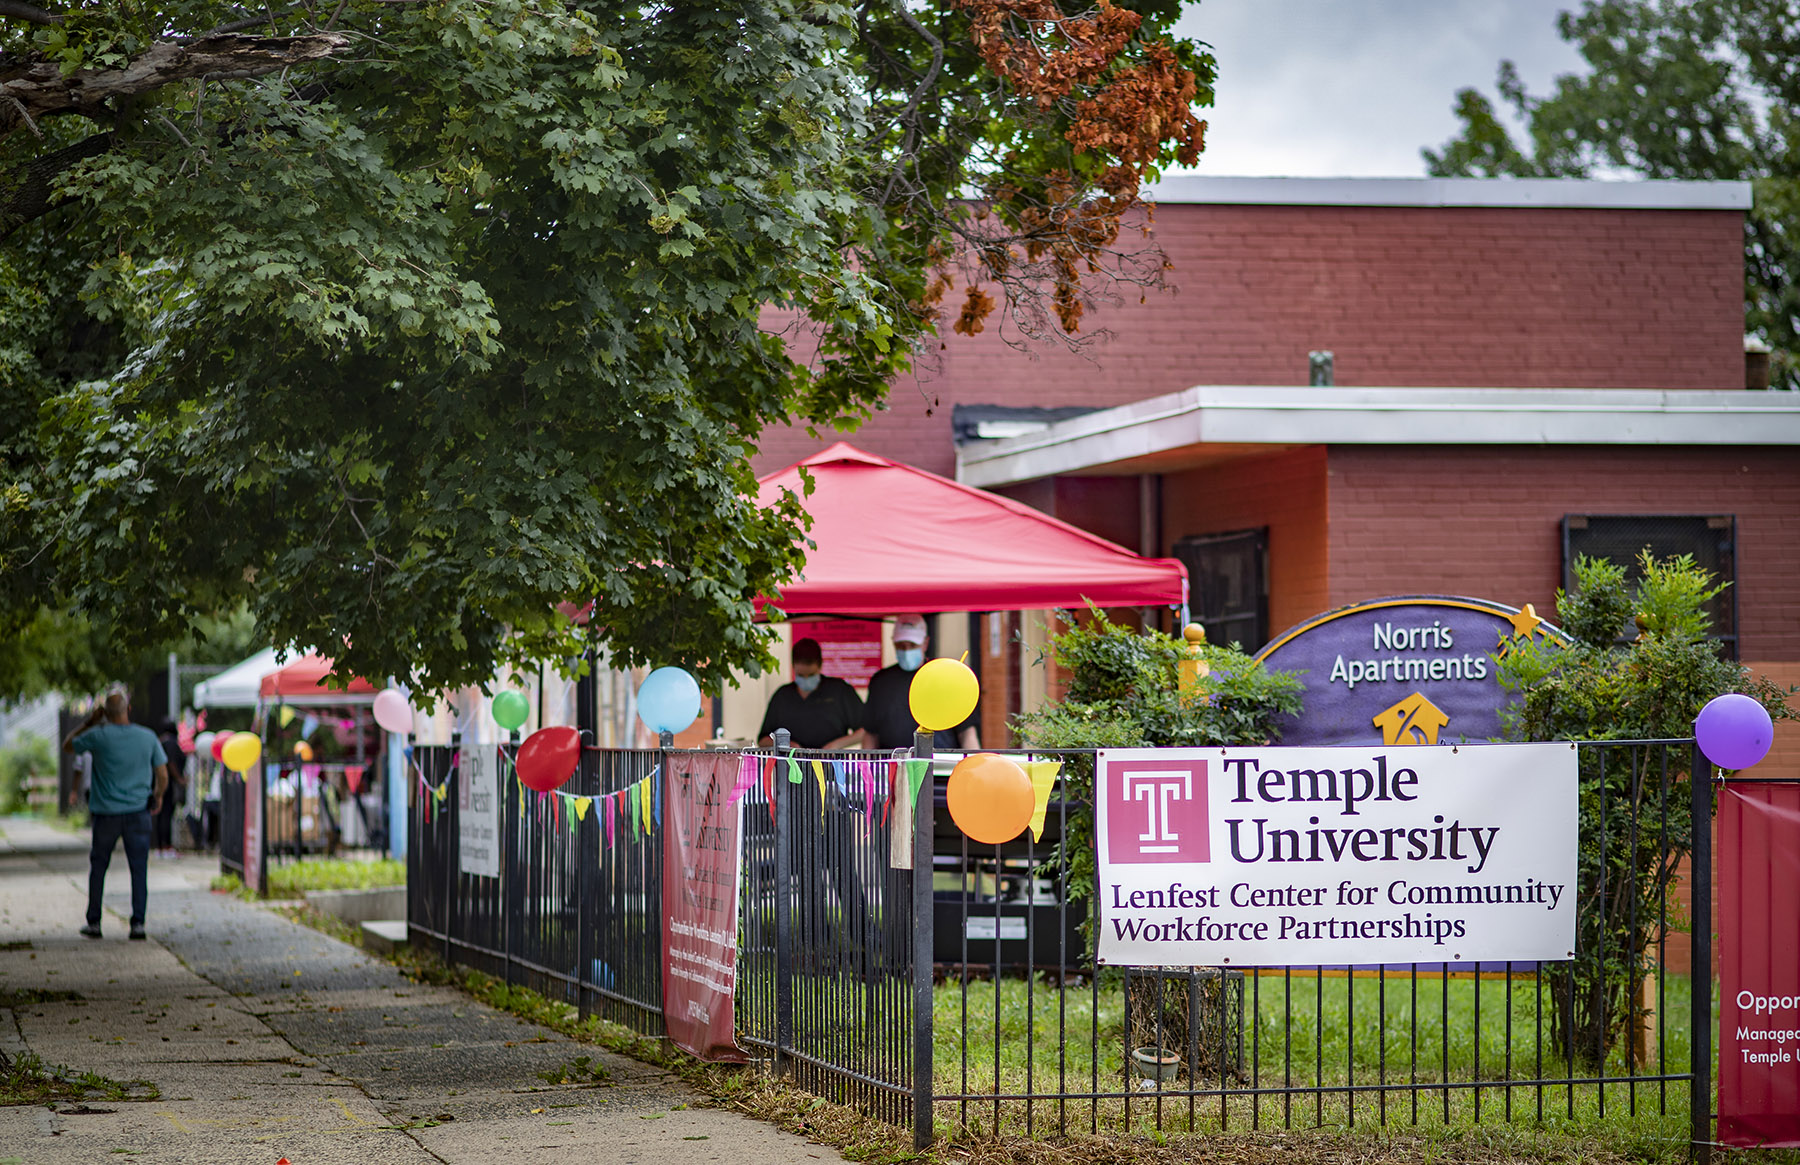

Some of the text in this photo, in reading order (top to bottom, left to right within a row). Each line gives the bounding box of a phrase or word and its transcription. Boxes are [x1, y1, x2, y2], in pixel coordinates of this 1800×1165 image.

[1374, 620, 1453, 650] Norris
[1329, 653, 1487, 689] Apartments
[1223, 755, 1419, 815] Temple
[1224, 815, 1500, 874] University
[1111, 878, 1565, 910] Lenfest Center for Community
[1111, 912, 1466, 946] Workforce Partnerships
[1741, 1047, 1791, 1067] Temple
